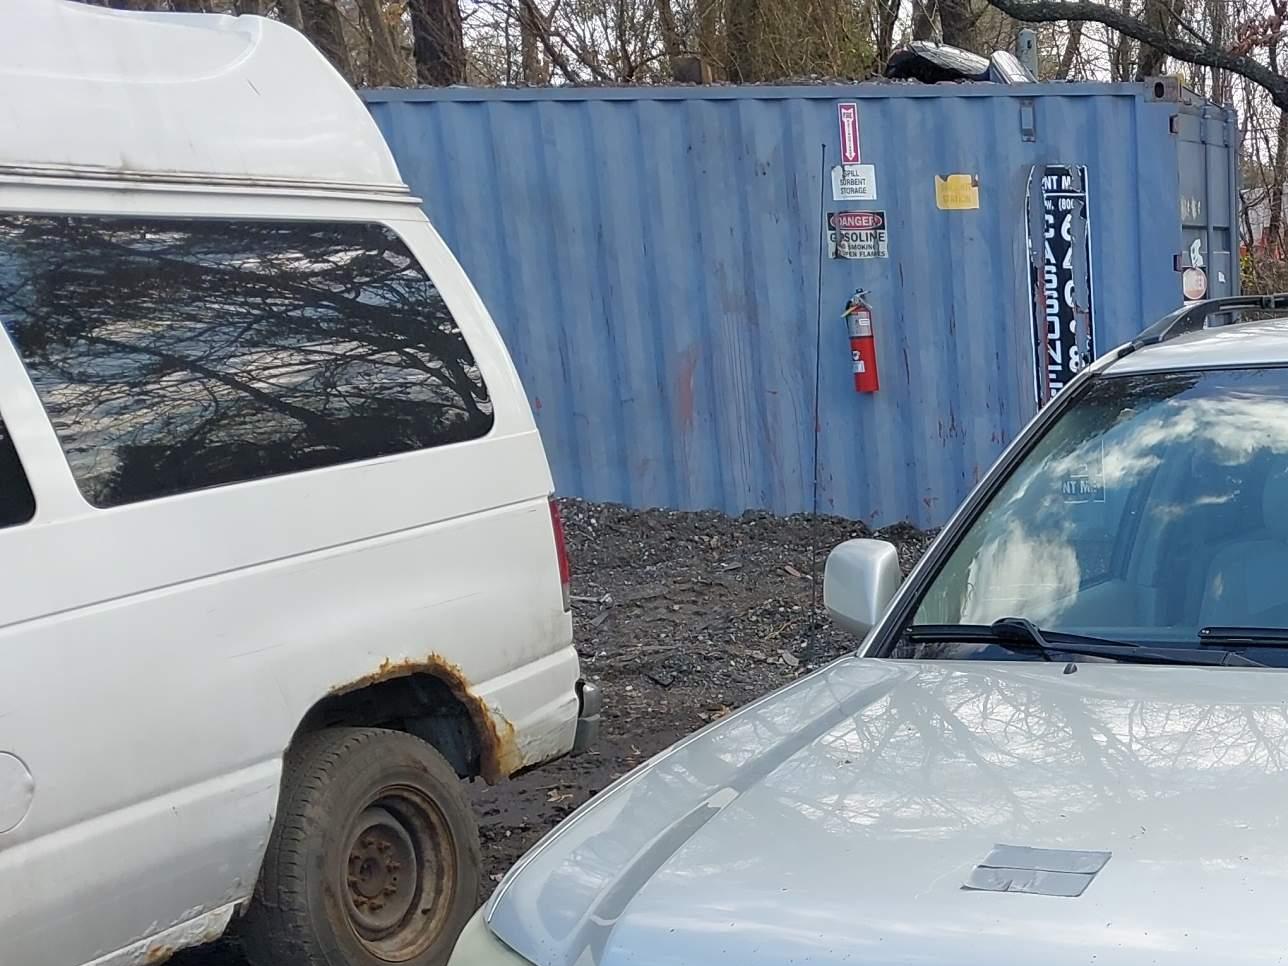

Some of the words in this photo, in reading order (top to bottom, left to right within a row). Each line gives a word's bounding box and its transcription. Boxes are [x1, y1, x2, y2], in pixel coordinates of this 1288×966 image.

[840, 178, 866, 186] SORBENT
[1042, 175, 1058, 190] NT
[840, 187, 867, 195] STORAGE
[830, 231, 886, 243] GSOLINE
